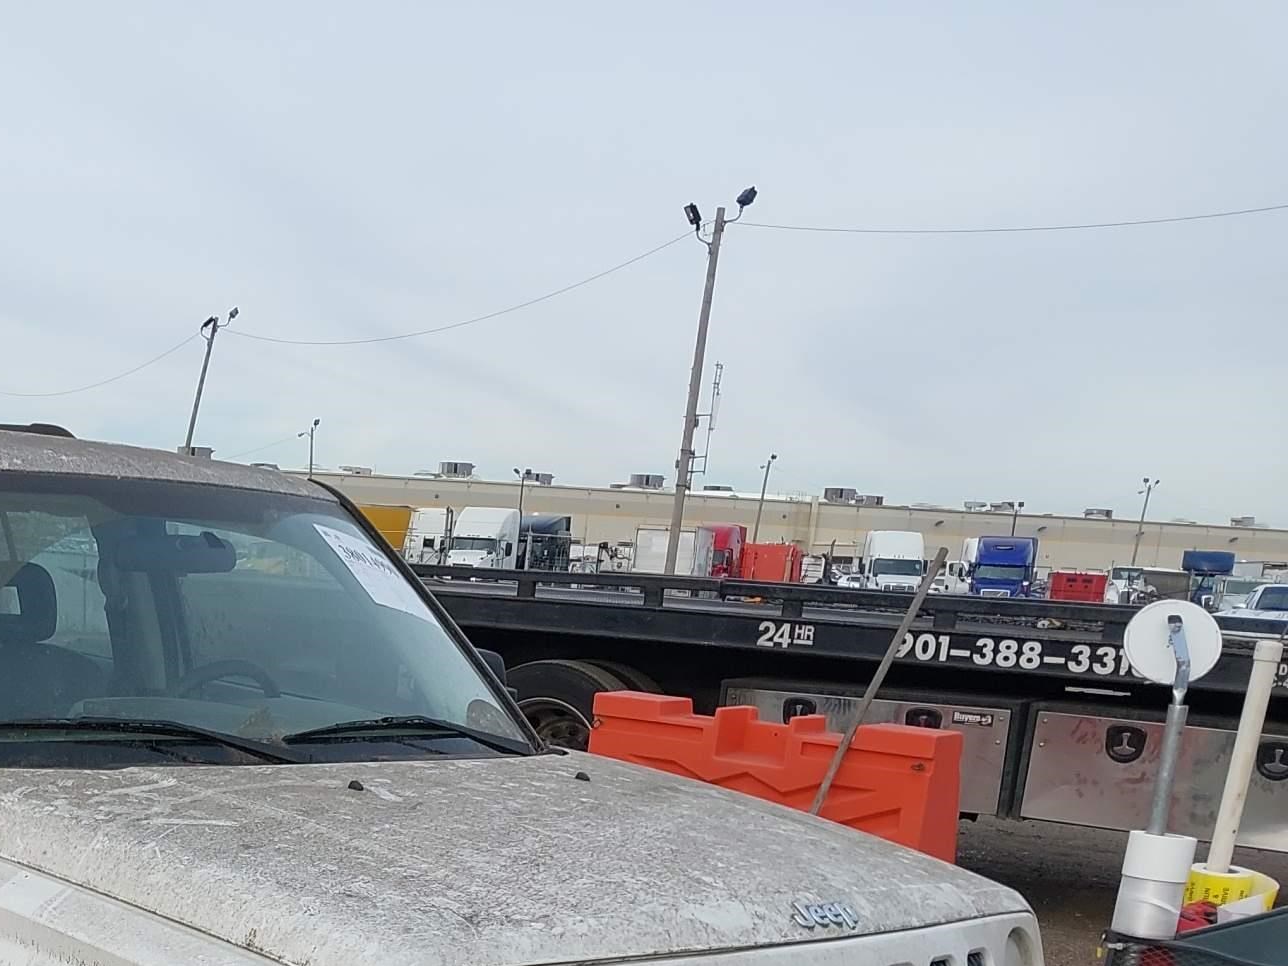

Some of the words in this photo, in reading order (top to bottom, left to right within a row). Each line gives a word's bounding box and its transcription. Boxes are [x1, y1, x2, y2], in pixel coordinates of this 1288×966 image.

[756, 621, 791, 648] 24
[794, 624, 815, 641] HR
[894, 632, 1144, 678] 901-388-331
[792, 902, 858, 929] Jeep
